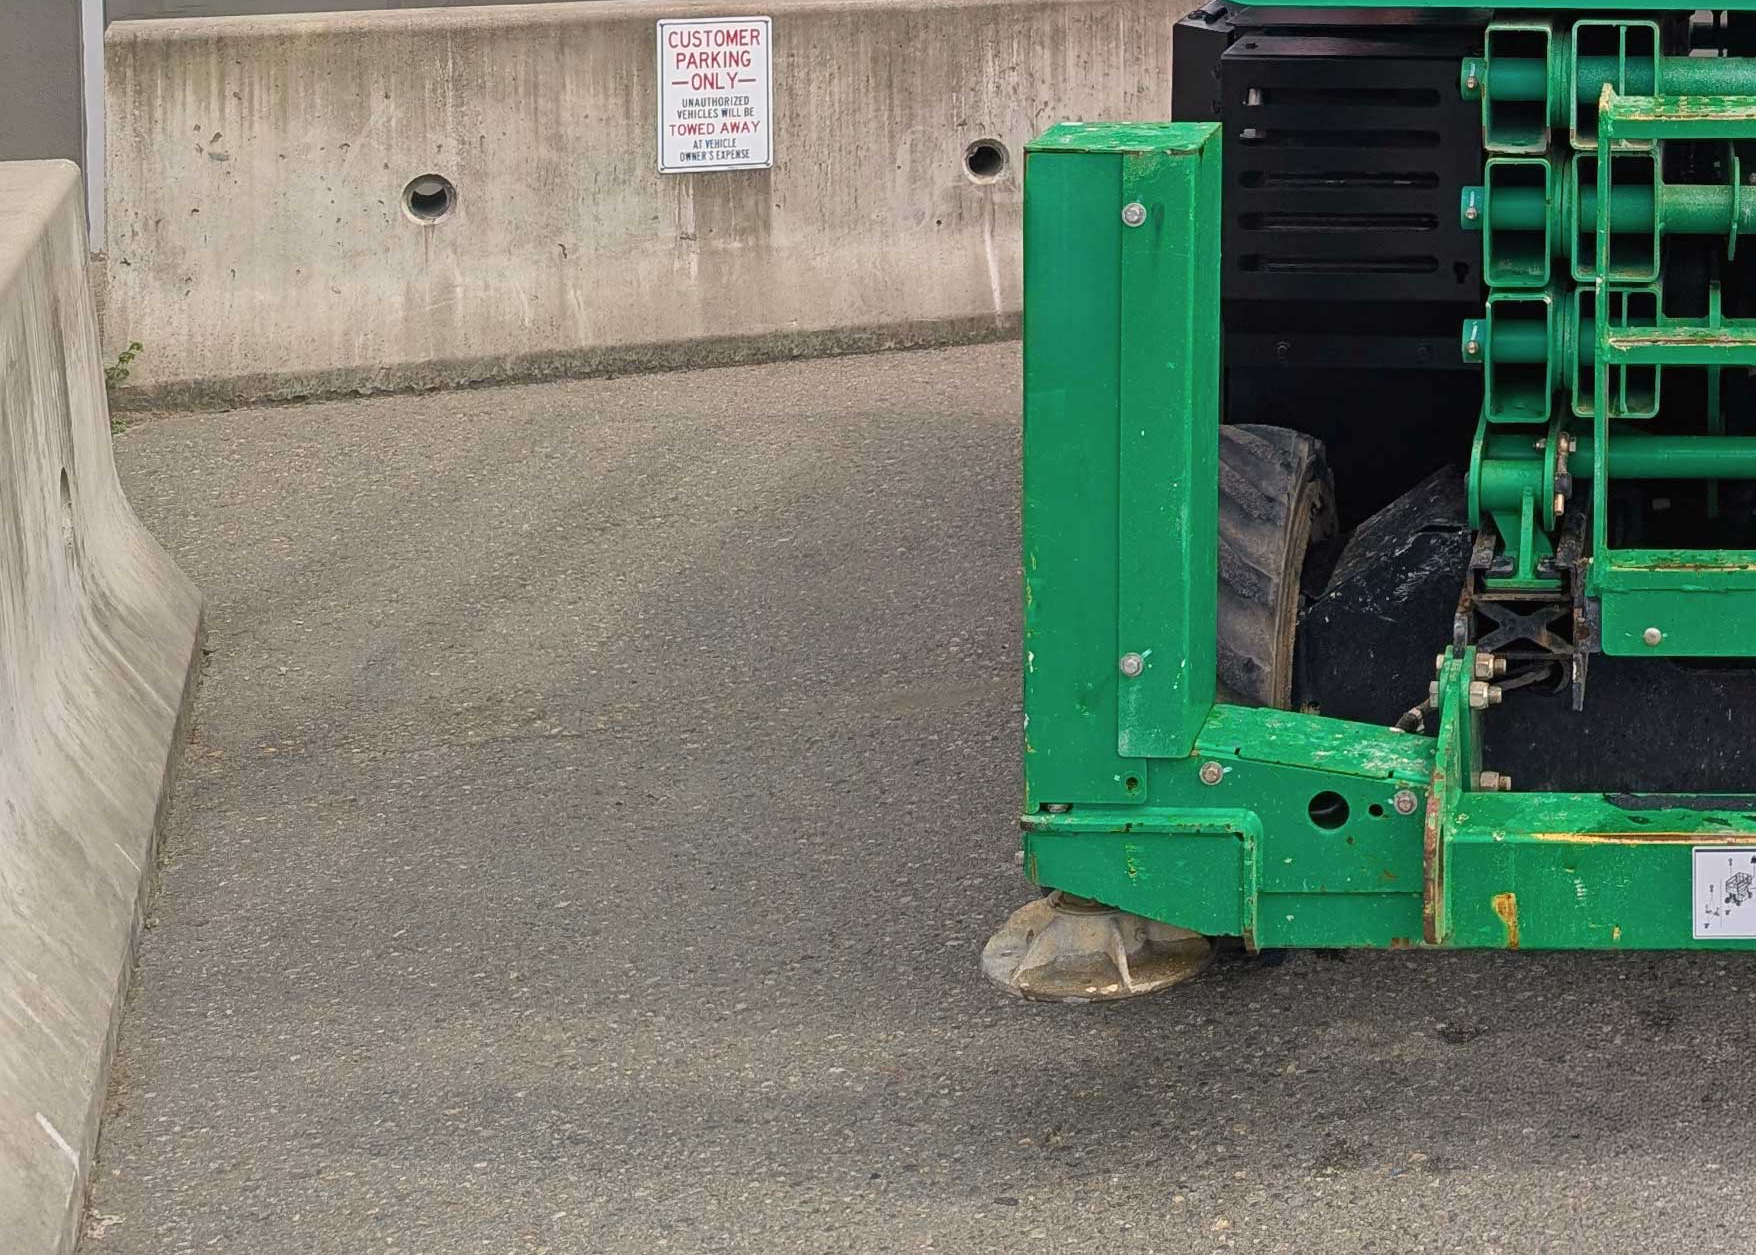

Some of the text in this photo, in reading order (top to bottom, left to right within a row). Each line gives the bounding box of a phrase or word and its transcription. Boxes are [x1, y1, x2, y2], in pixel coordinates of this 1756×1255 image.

[668, 28, 760, 48] CUSTOMER
[675, 50, 752, 69] PARKING
[682, 95, 749, 108] UNAUTHORIZED
[677, 107, 754, 119] VEHICLES WILL BE
[669, 120, 761, 136] TOWED AWAY
[693, 138, 737, 150] AT VEHICLE
[680, 149, 750, 162] OWNER'S EXPENSE
